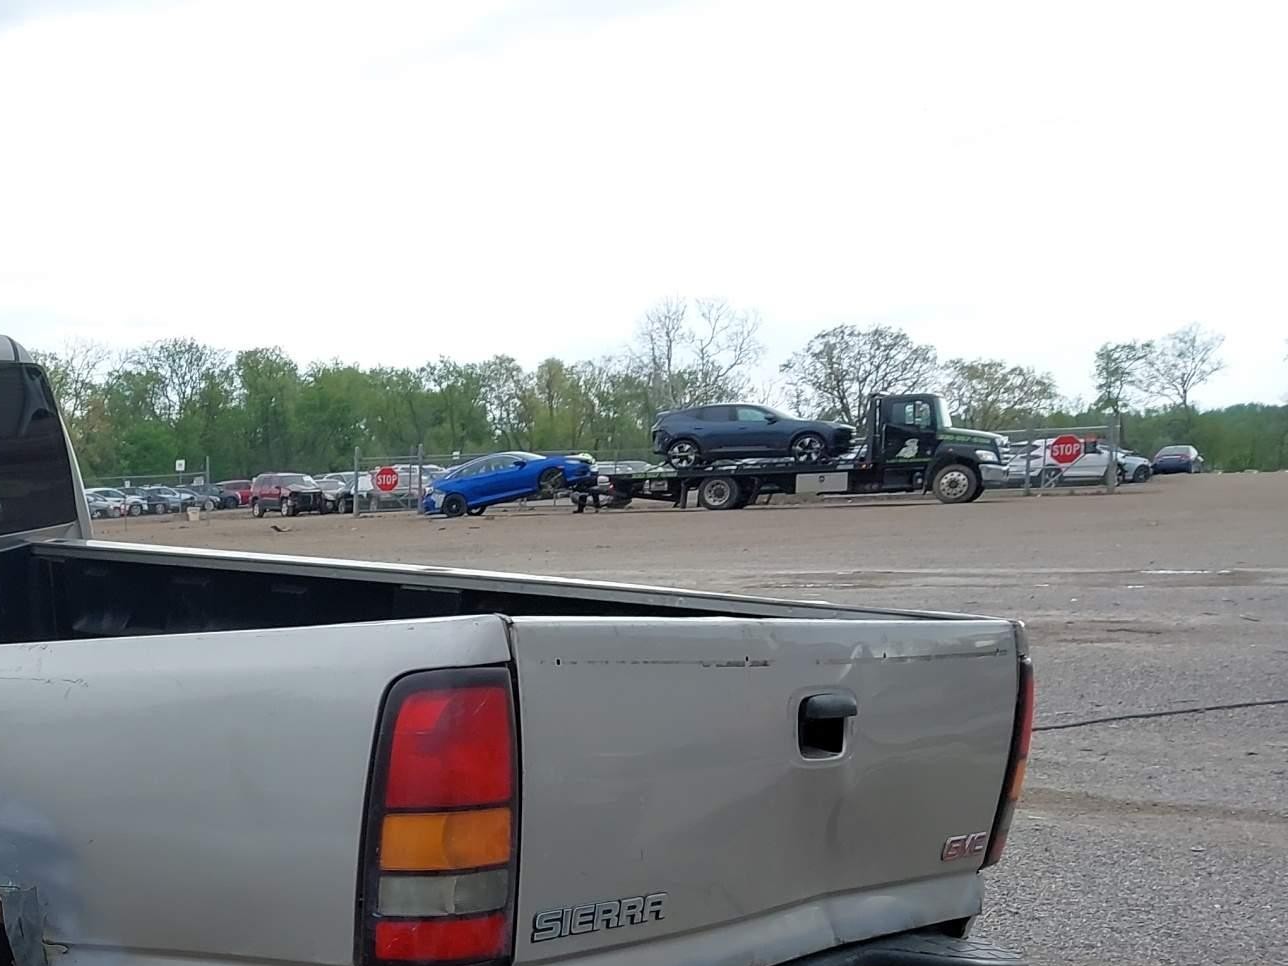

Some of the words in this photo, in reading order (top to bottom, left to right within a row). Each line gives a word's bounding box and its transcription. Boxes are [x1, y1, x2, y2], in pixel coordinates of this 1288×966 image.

[1052, 443, 1081, 456] STOP
[377, 474, 398, 485] STOP
[531, 892, 669, 943] SIERRA
